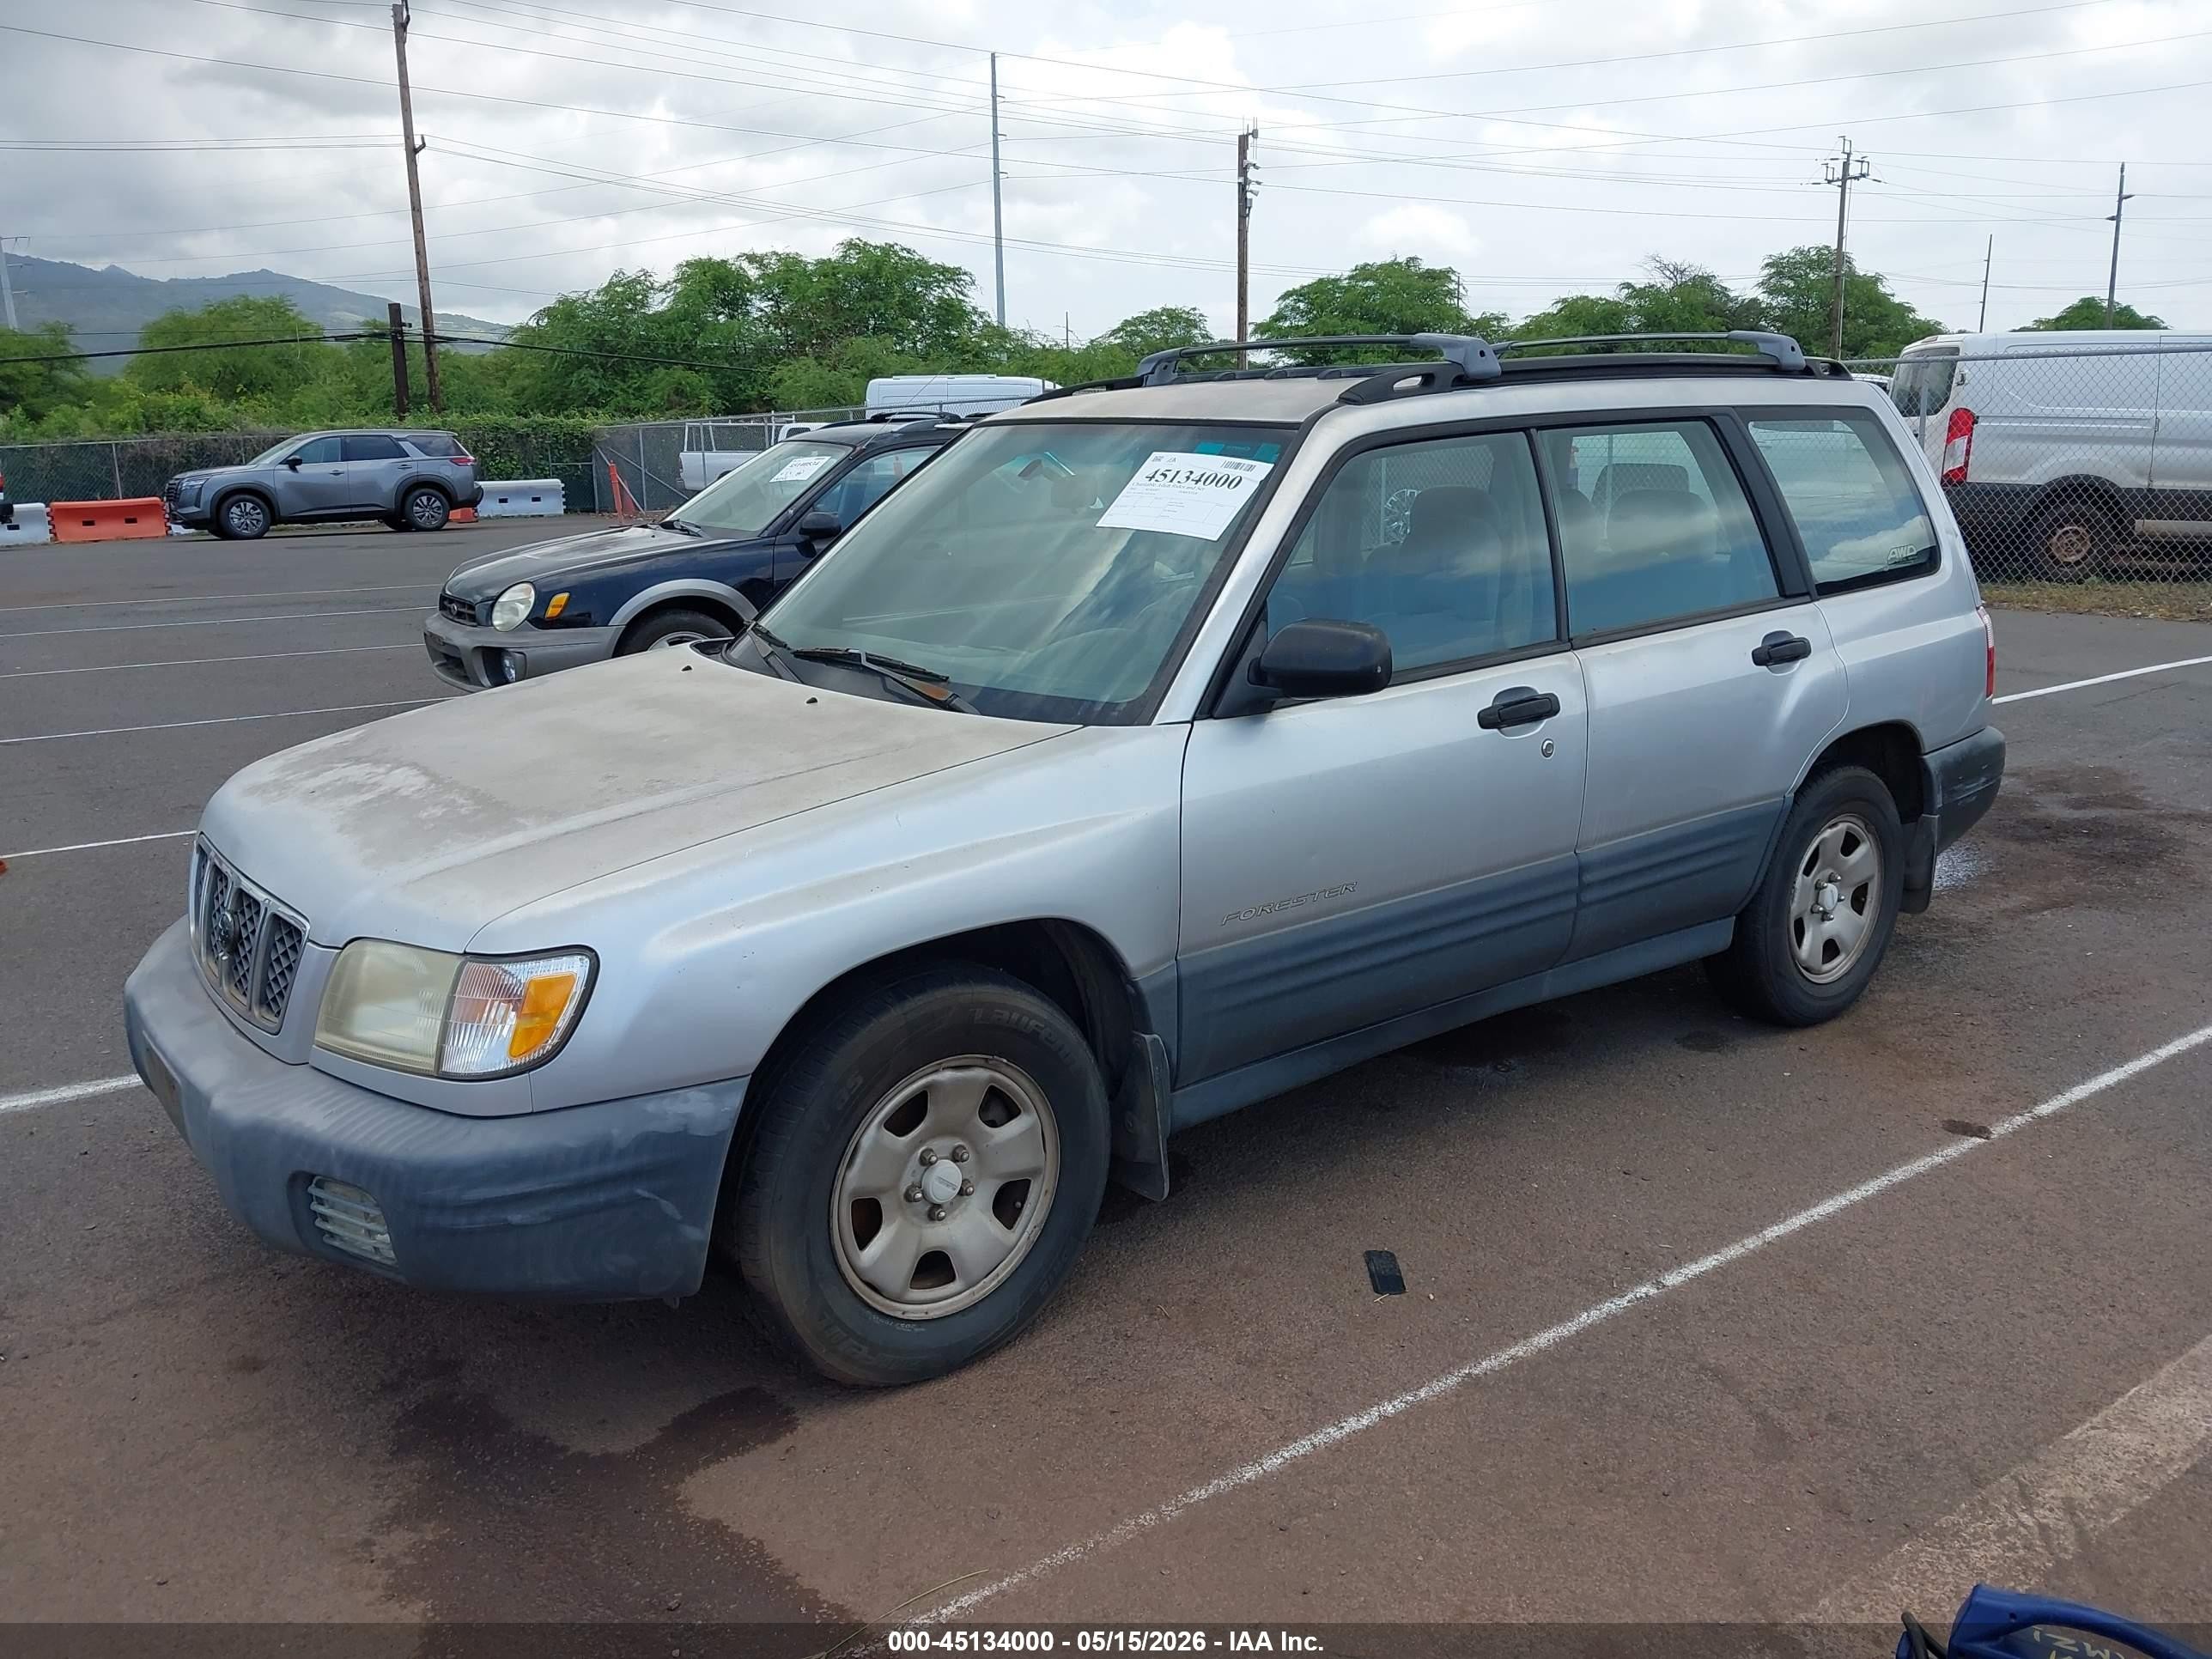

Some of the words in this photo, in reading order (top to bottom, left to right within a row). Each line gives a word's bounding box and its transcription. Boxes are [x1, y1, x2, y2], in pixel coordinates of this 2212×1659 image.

[1145, 467, 1243, 489] 45134000
[1887, 544, 1917, 562] AWD
[1221, 881, 1358, 926] FORESTER
